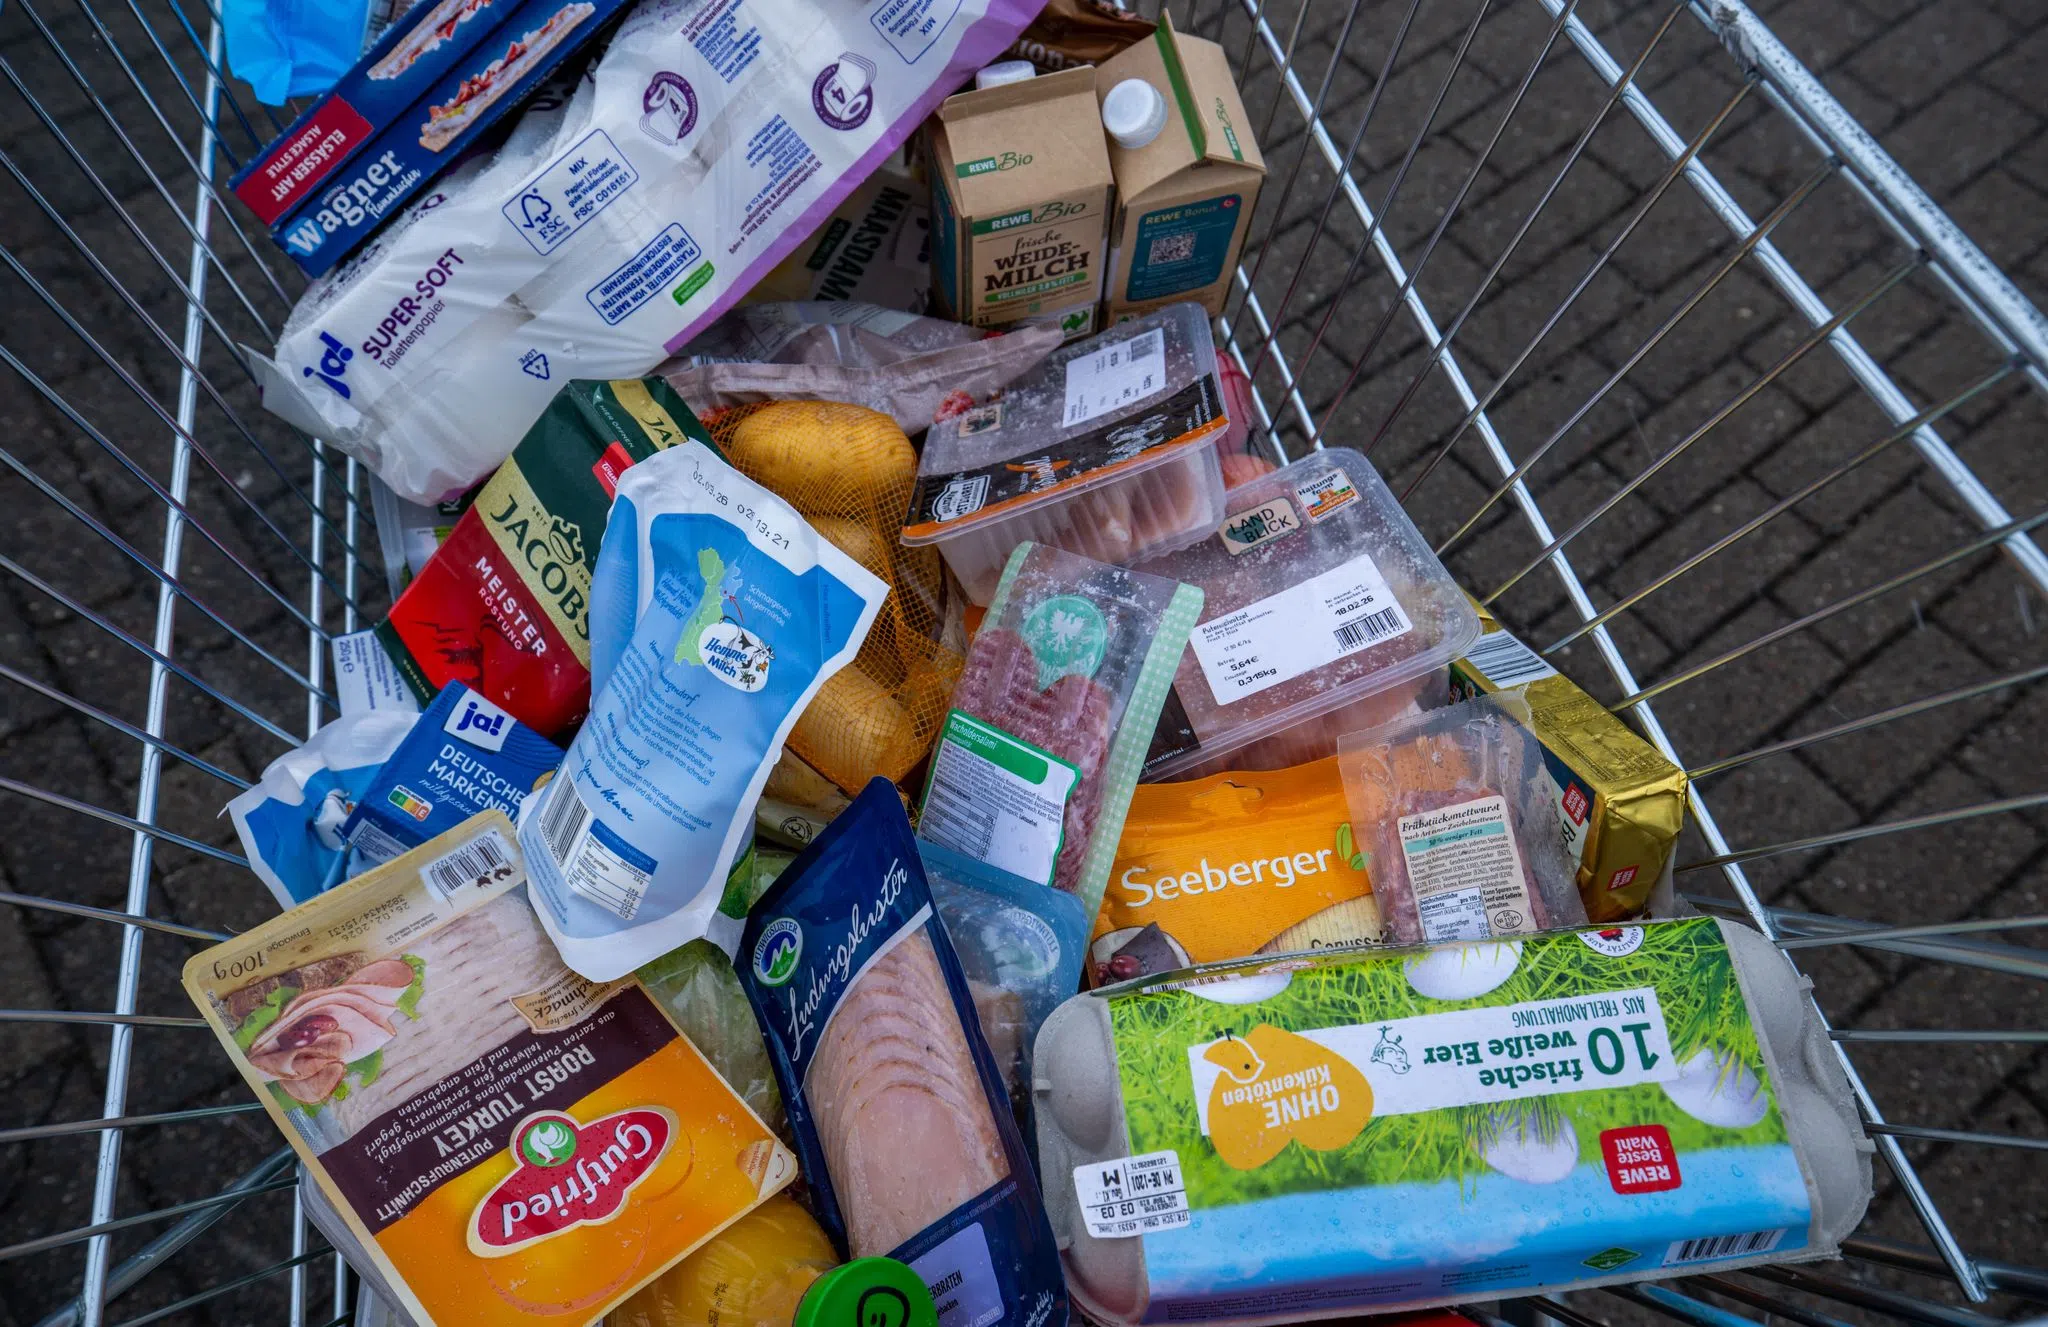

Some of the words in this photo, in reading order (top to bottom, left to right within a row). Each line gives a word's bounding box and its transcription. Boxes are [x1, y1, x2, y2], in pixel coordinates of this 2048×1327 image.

[917, 15, 936, 35] MIX
[664, 97, 683, 115] 4
[828, 83, 851, 105] 4
[288, 124, 324, 157] ALSACE
[289, 128, 348, 182] ELSÄSSER
[265, 152, 294, 178] STYLE
[568, 156, 588, 175] MIX
[968, 158, 995, 173] REWE
[995, 147, 1034, 172] Bio
[268, 174, 298, 201] ART
[563, 178, 586, 199] Papier
[586, 156, 610, 178] Fördert
[567, 193, 583, 208] gute
[580, 161, 620, 195] Waldnutzung
[595, 171, 632, 203] C016151
[537, 214, 565, 240] FSC
[990, 212, 1030, 230] REWE
[1030, 195, 1089, 224] Bio
[1143, 208, 1182, 227] REWE
[670, 236, 688, 253] UND
[993, 239, 1083, 272] WEIDE-
[1009, 227, 1065, 257] frische
[641, 249, 672, 278] KINDERN
[644, 245, 695, 290] PLASTIKBEUTEL
[981, 250, 1094, 292] MILCH
[359, 246, 466, 361] SUPER-SOFT
[629, 286, 647, 303] VON
[606, 299, 631, 321] BABYS
[380, 297, 448, 371] Toilettenpapier
[517, 347, 538, 365] LDPE
[1297, 472, 1338, 496] Haltungs
[529, 504, 548, 527] SEIT
[1228, 506, 1276, 536] LAND
[1242, 513, 1293, 544] BLICK
[752, 519, 791, 550] 13:21
[472, 555, 550, 658] MEISTER
[476, 585, 525, 651] RÖSTUNG
[1332, 593, 1375, 617] 18.02.26
[703, 632, 749, 669] Hemme
[706, 652, 739, 679] Milch
[1236, 666, 1278, 687] 0,315kg
[453, 697, 507, 749] ja!
[948, 719, 997, 750] Wacholdersalami
[1144, 745, 1185, 767] smaterial
[437, 742, 529, 807] DEUTSCHE
[1400, 802, 1501, 832] Frühstücksmettwurst
[1403, 832, 1420, 840] nach
[1443, 832, 1469, 842] weniger
[1469, 828, 1483, 836] Fett
[1120, 848, 1332, 908] Seeberger
[1482, 888, 1495, 896] Kann
[1494, 886, 1511, 895] Spuren
[1484, 895, 1496, 904] Senf
[1504, 890, 1522, 900] Sellerie
[263, 924, 312, 956] Einwaage
[753, 921, 799, 967] LUDWIGSLUSTER
[1587, 936, 1604, 948] AUS
[1606, 932, 1638, 952] QUALITÄT
[209, 959, 228, 982] g
[226, 949, 266, 980] 100
[788, 857, 909, 1062] Ludwigsluster
[530, 976, 597, 1024] schmack
[1511, 1000, 1605, 1028] FREILANDHALTUNG
[1608, 993, 1647, 1015] AUS
[596, 1009, 616, 1026] aus
[561, 1021, 597, 1047] zarten
[1487, 1030, 1576, 1058] weiße
[487, 1044, 510, 1064] und
[494, 1040, 542, 1074] teilweise
[1423, 1039, 1484, 1063] Eier
[1590, 1023, 1660, 1076] 10
[460, 1057, 486, 1079] fein
[470, 1066, 495, 1088] fein
[472, 1042, 563, 1103] Putenmedaillons
[521, 1041, 596, 1100] ROAST
[1479, 1059, 1585, 1089] frische
[394, 1071, 462, 1118] angebraten
[1220, 1064, 1331, 1108] Kükentöten
[1261, 1083, 1340, 1127] OHNE
[429, 1087, 524, 1157] TURKEY
[360, 1119, 404, 1156] gegart
[1613, 1133, 1658, 1153] Wahl
[1617, 1147, 1662, 1167] Beste
[373, 1136, 495, 1223] PUTENAUFSCHNITT
[500, 1122, 653, 1241] Gutfried
[1101, 1168, 1120, 1187] M
[1162, 1169, 1174, 1185] PN
[1617, 1163, 1671, 1186] REWE
[926, 1269, 964, 1300] ERBRATEN
